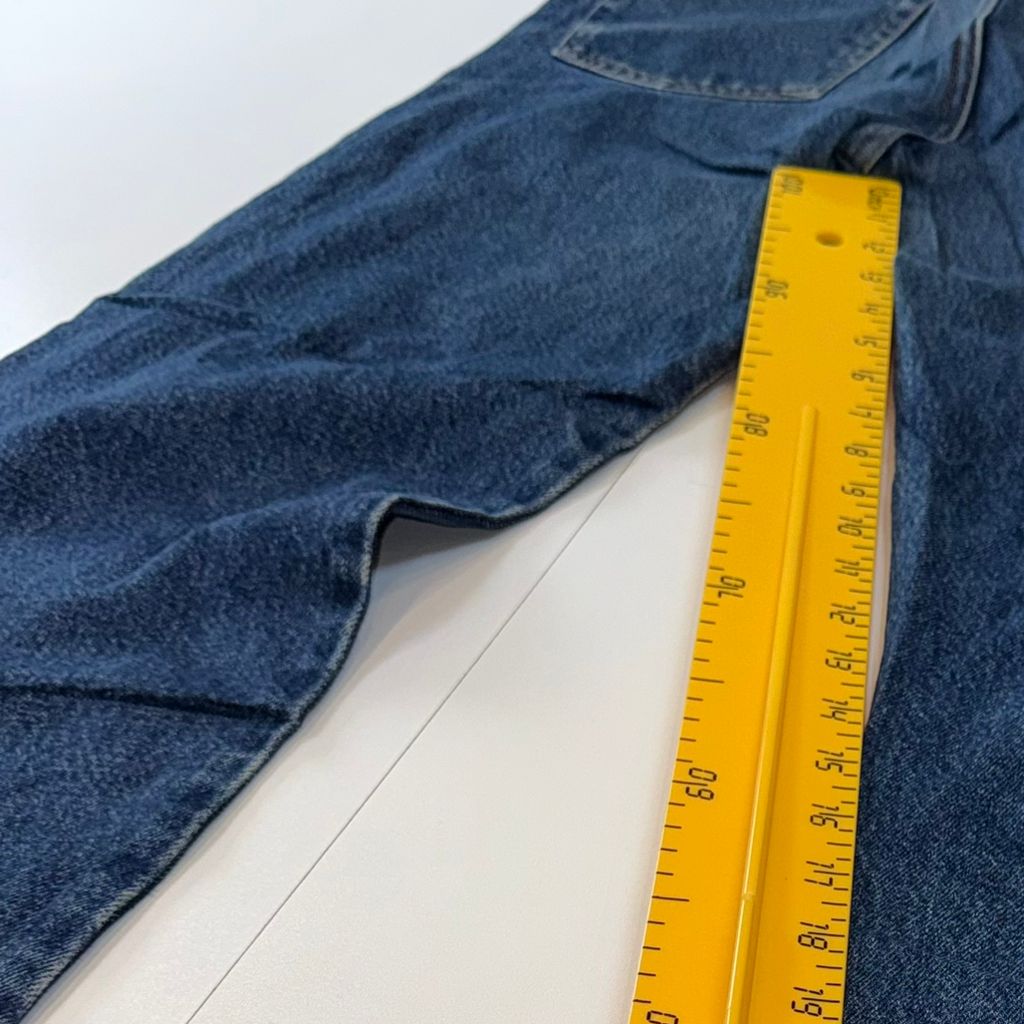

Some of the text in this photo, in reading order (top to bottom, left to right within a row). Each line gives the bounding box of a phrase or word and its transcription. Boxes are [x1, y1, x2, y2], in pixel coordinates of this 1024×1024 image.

[765, 279, 789, 299] 90
[853, 337, 878, 348] 5
[851, 372, 875, 383] 6
[744, 412, 770, 437] 80
[848, 409, 872, 418] 7
[844, 446, 869, 458] 8
[841, 485, 866, 498] 9
[837, 516, 863, 537] 10
[834, 559, 860, 577] 11
[718, 575, 746, 599] 70
[829, 603, 856, 625] 12
[825, 649, 852, 672] 13
[820, 698, 849, 722] 14
[815, 749, 844, 773] 15
[685, 767, 718, 801] 60
[810, 803, 839, 829] 16
[804, 861, 834, 887] 17
[798, 921, 829, 950] 18
[791, 987, 824, 1017] 19
